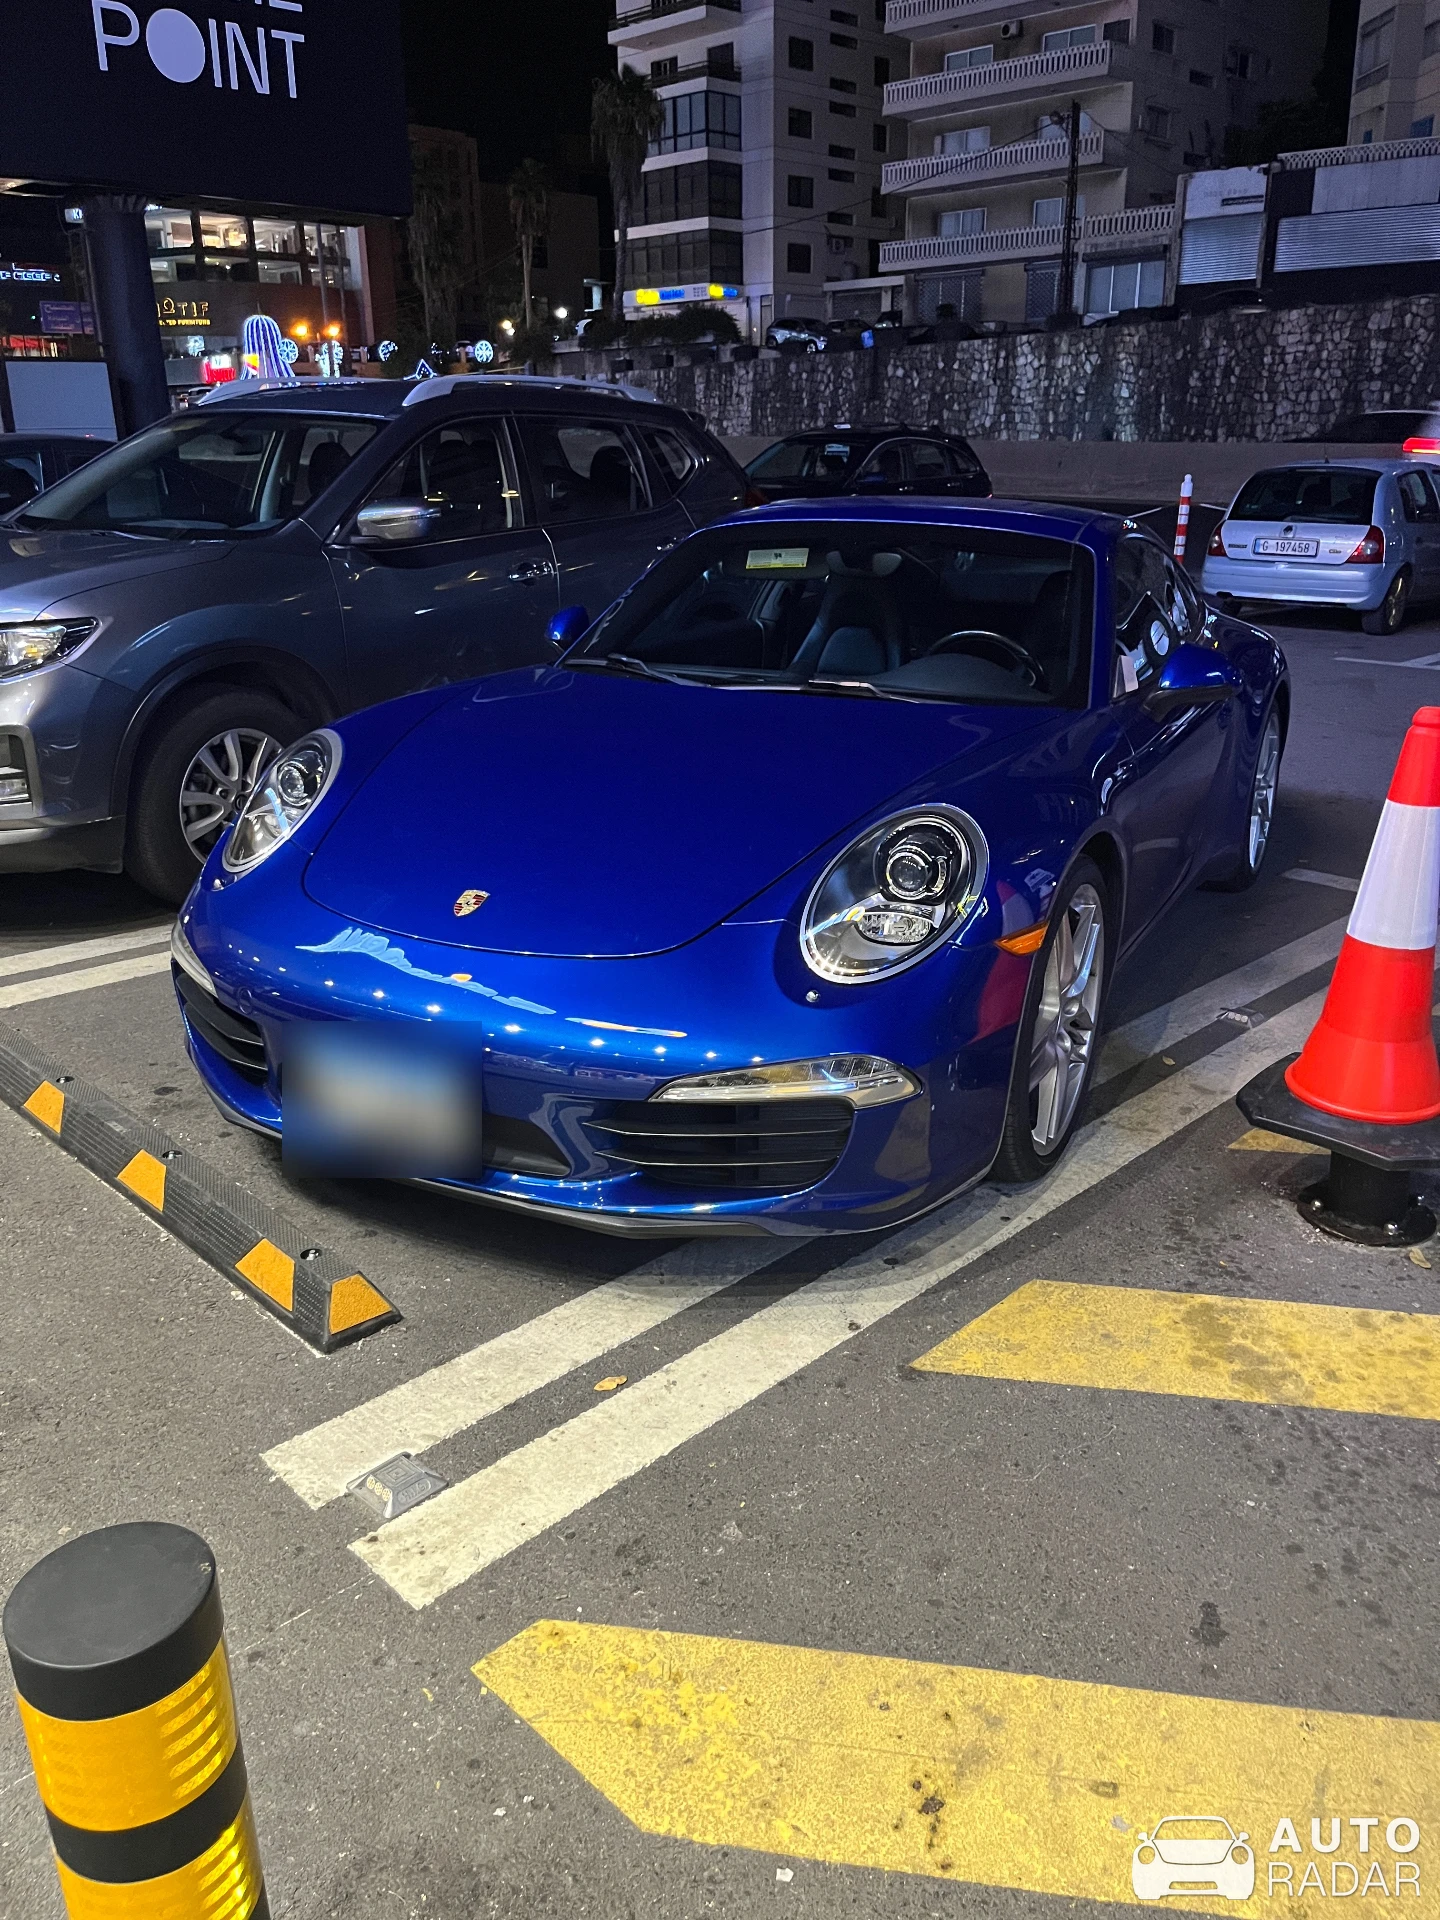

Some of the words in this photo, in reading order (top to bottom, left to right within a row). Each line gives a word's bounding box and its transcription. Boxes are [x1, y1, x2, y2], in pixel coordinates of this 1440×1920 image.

[92, 0, 305, 99] POINT
[1262, 541, 1269, 551] G
[1275, 541, 1310, 553] 197458
